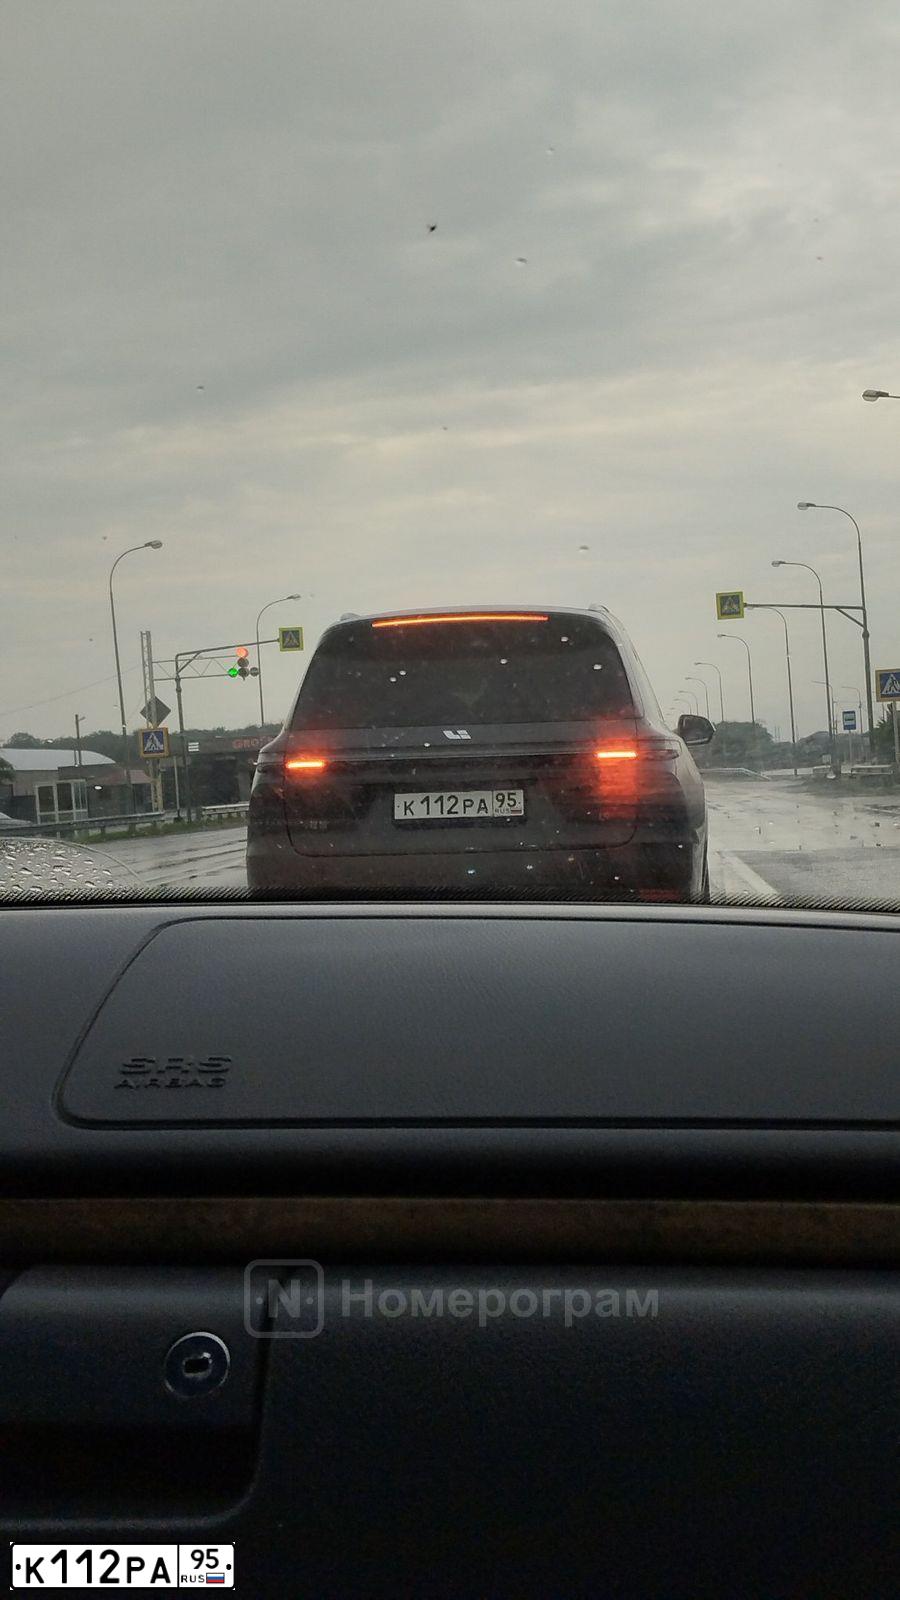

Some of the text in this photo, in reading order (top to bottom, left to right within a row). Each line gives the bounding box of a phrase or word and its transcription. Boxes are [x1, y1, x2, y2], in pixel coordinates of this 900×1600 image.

[495, 792, 517, 808] 95
[120, 1056, 232, 1075] SRS
[114, 1078, 226, 1089] AIRBAG
